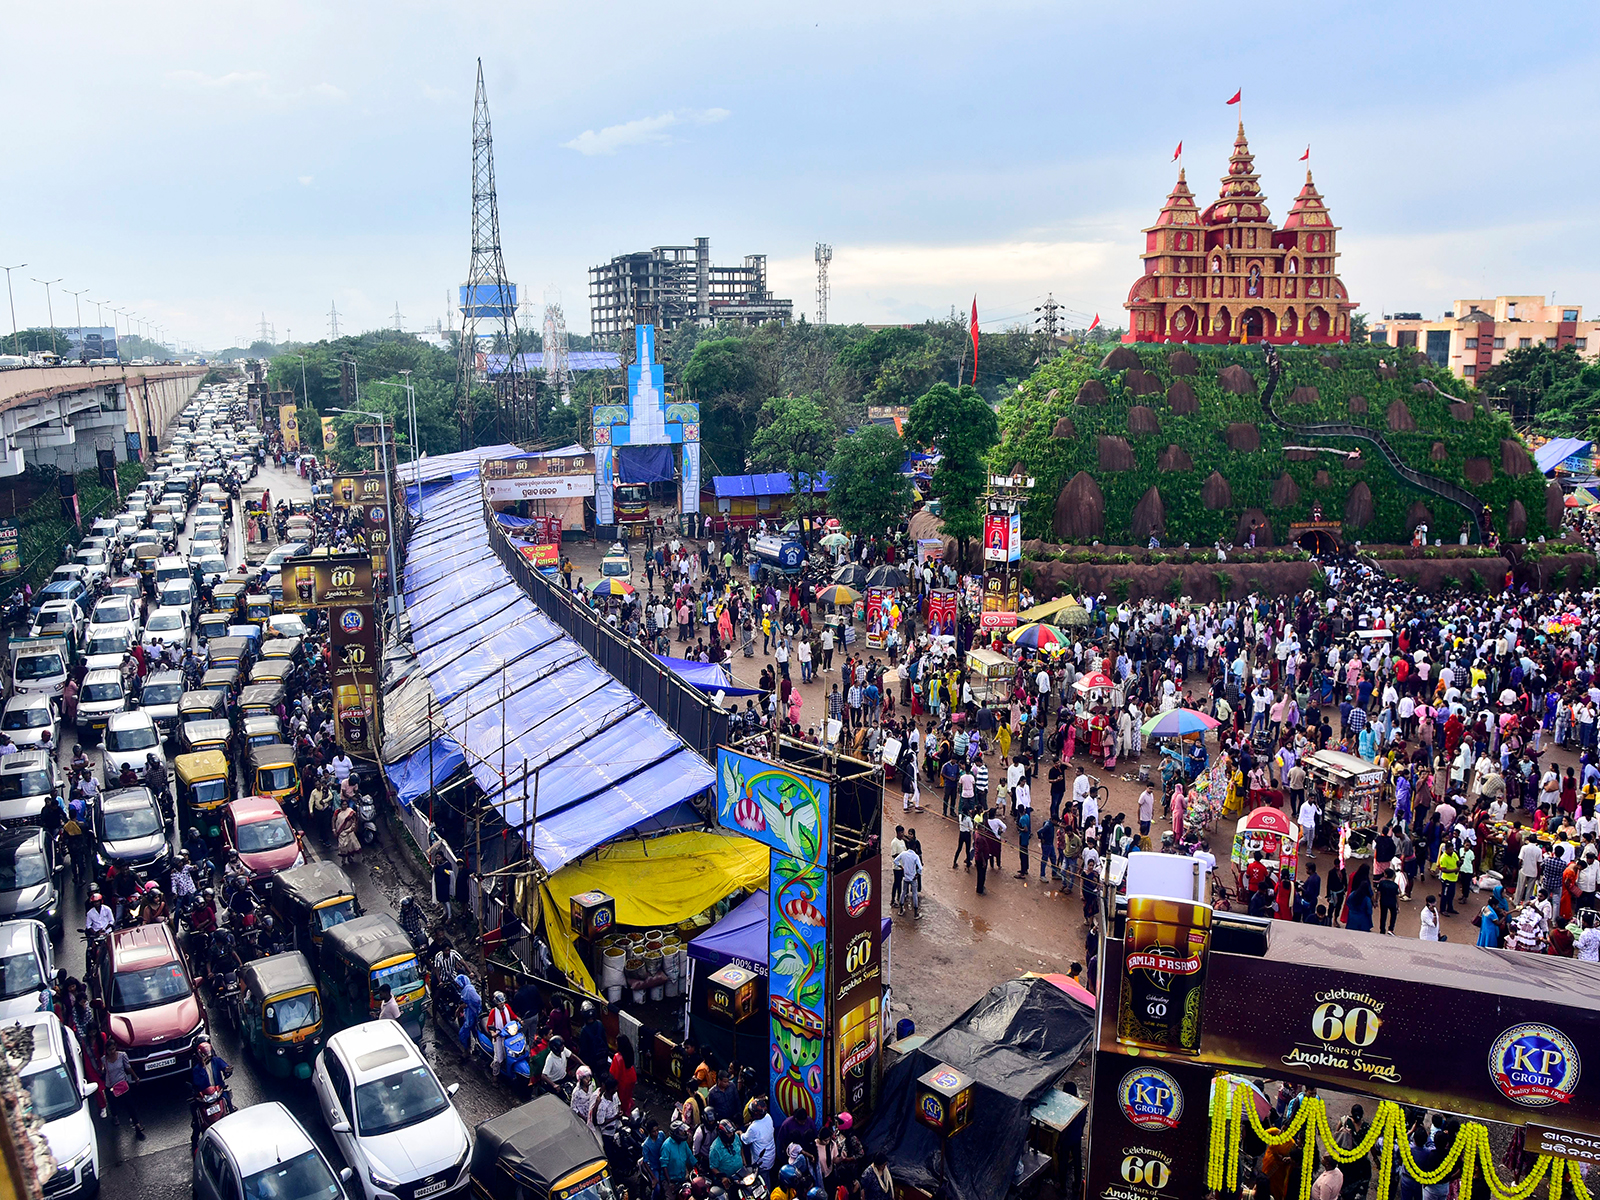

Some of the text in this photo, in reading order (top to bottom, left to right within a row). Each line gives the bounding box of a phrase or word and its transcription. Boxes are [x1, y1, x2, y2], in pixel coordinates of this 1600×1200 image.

[331, 571, 356, 587] 60
[346, 615, 359, 624] KP
[852, 881, 867, 901] KP
[732, 957, 752, 970] 100%
[846, 938, 872, 973] 60
[1158, 958, 1198, 971] PASAND
[1146, 1002, 1167, 1017] 60
[1315, 989, 1385, 1014] Celebrating
[1312, 1002, 1380, 1047] 60
[1323, 1043, 1363, 1057] Years of
[1281, 1048, 1401, 1083] Anokha Swad
[1511, 1044, 1562, 1076] KP
[1511, 1071, 1554, 1087] GROUP
[1134, 1083, 1170, 1107] KP
[1508, 1087, 1531, 1096] Quality
[1532, 1086, 1549, 1094] Since
[926, 1100, 940, 1115] KP
[1135, 1104, 1165, 1115] GROUP
[1122, 1145, 1172, 1166] Celebrating
[1121, 1155, 1169, 1189] 60
[1129, 1184, 1149, 1194] Years
